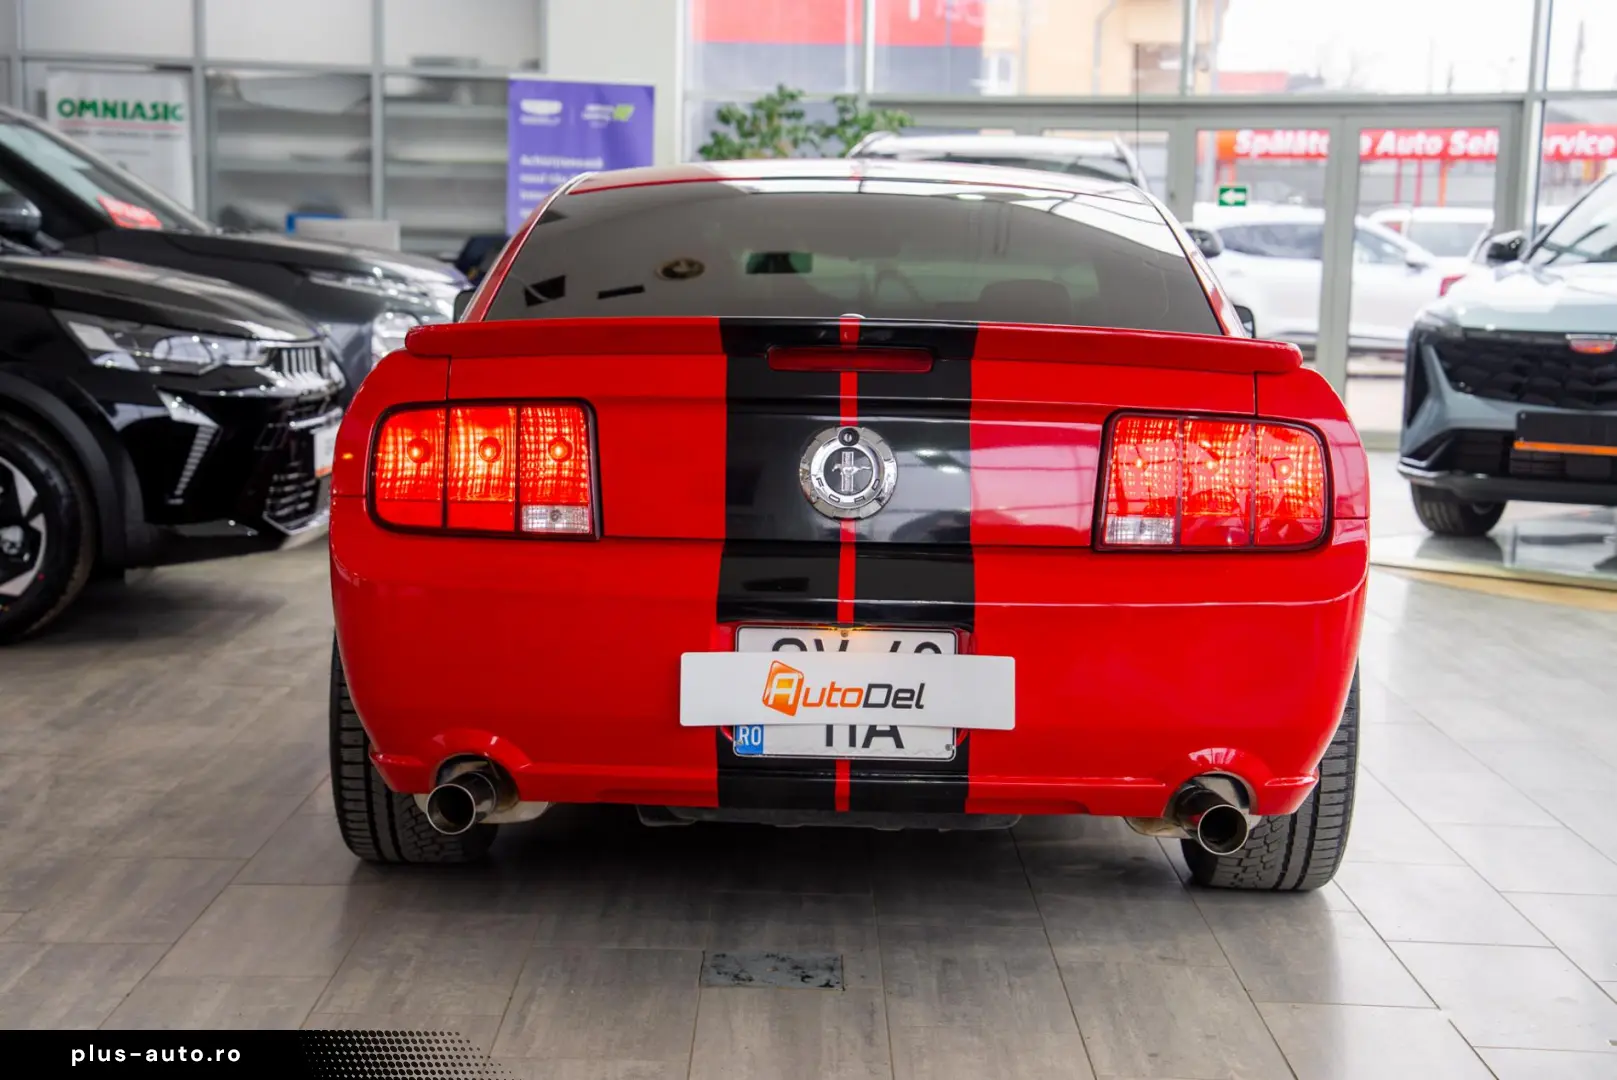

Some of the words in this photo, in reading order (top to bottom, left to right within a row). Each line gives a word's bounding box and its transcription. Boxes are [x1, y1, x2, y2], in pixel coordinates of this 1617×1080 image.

[1376, 130, 1443, 156] Auto
[766, 671, 926, 710] AutoDel
[738, 726, 762, 746] RO
